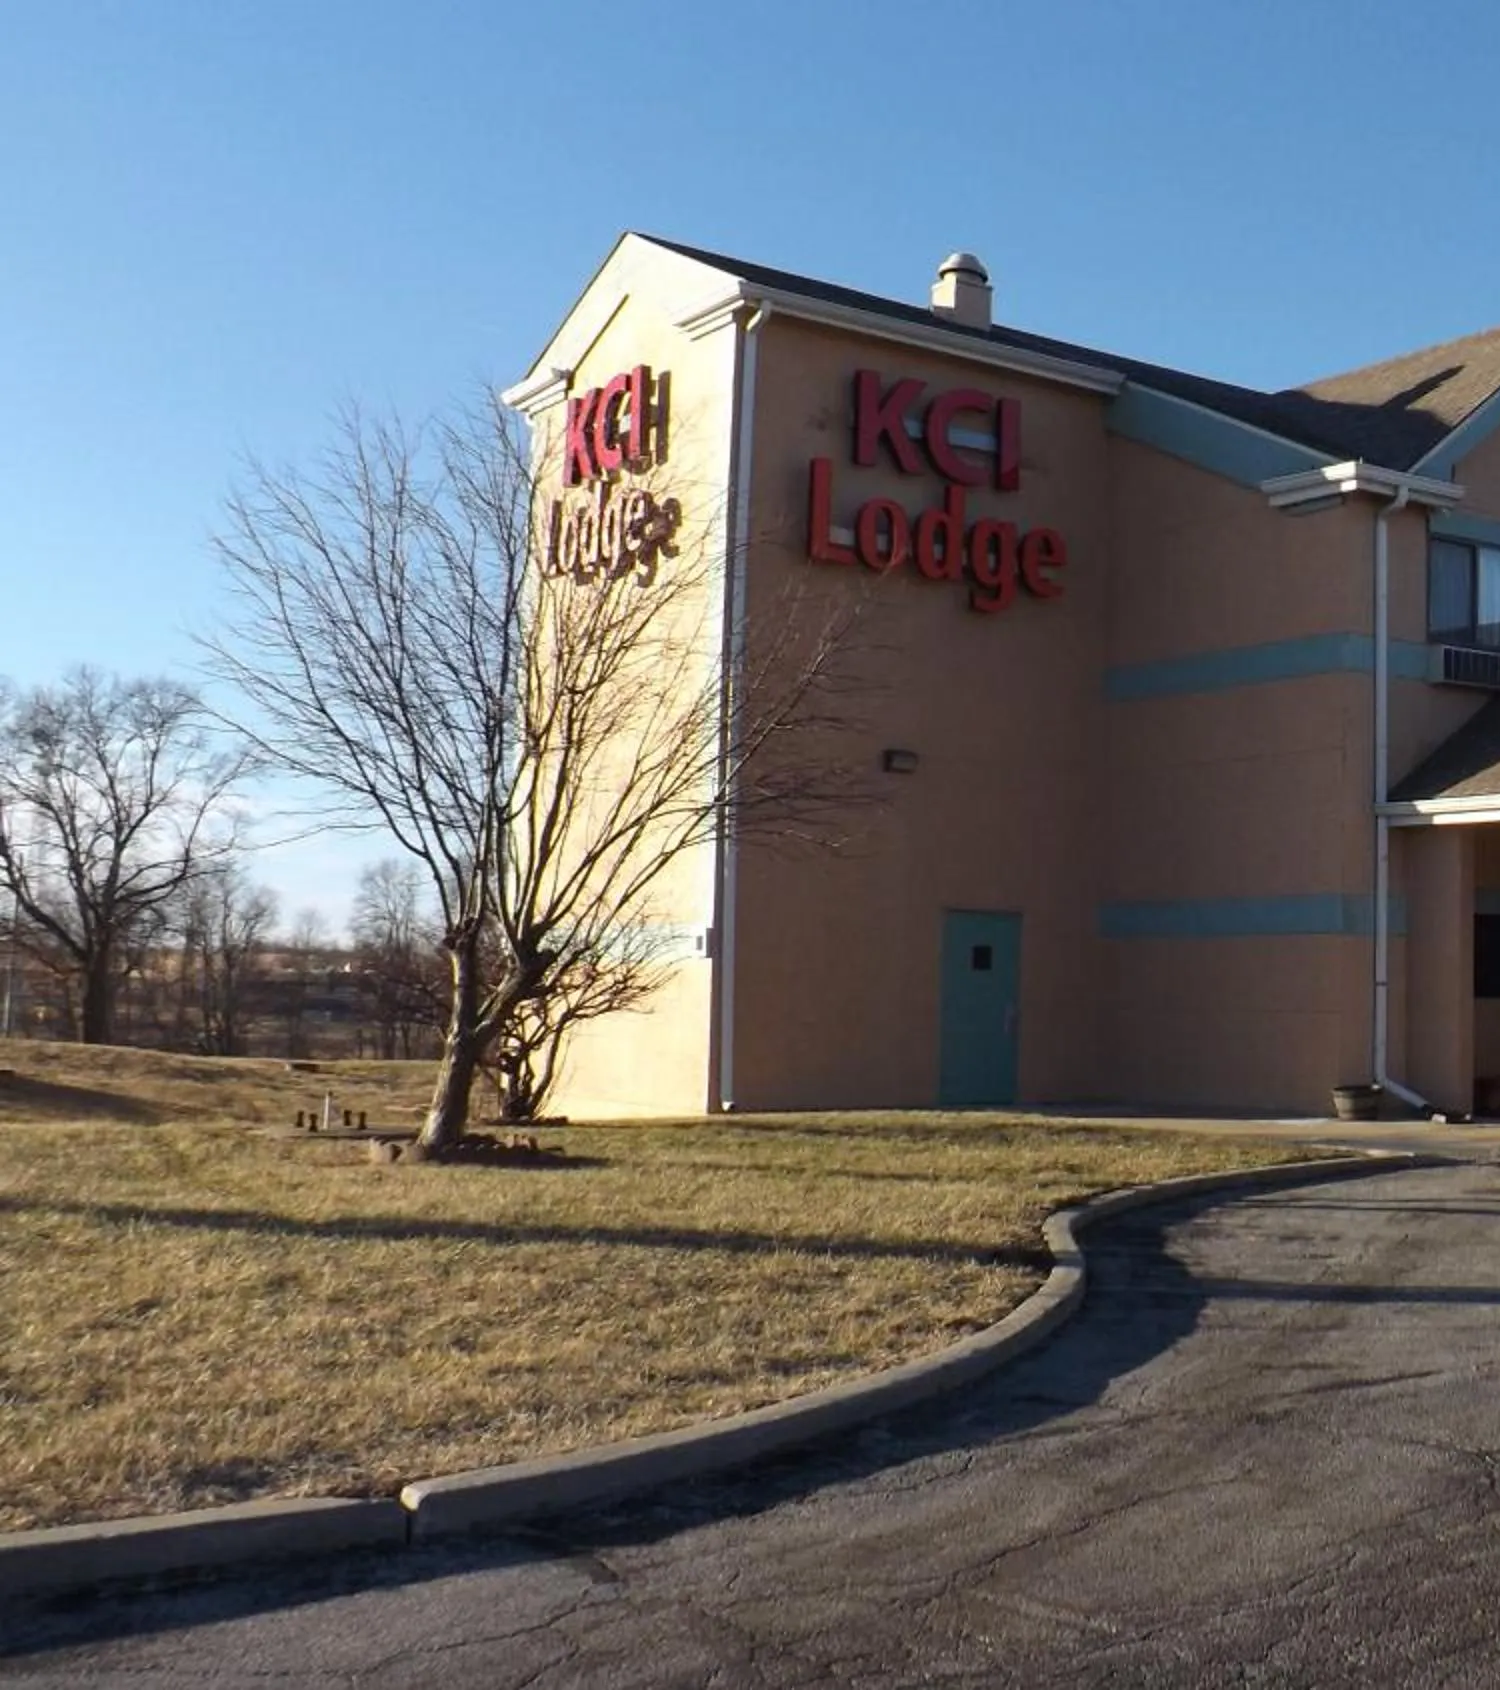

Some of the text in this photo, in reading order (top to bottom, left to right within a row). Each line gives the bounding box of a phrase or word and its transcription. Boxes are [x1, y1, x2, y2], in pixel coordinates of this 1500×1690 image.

[563, 364, 652, 487] KCI
[853, 369, 1022, 491] KCI
[808, 456, 1068, 613] Lodge
